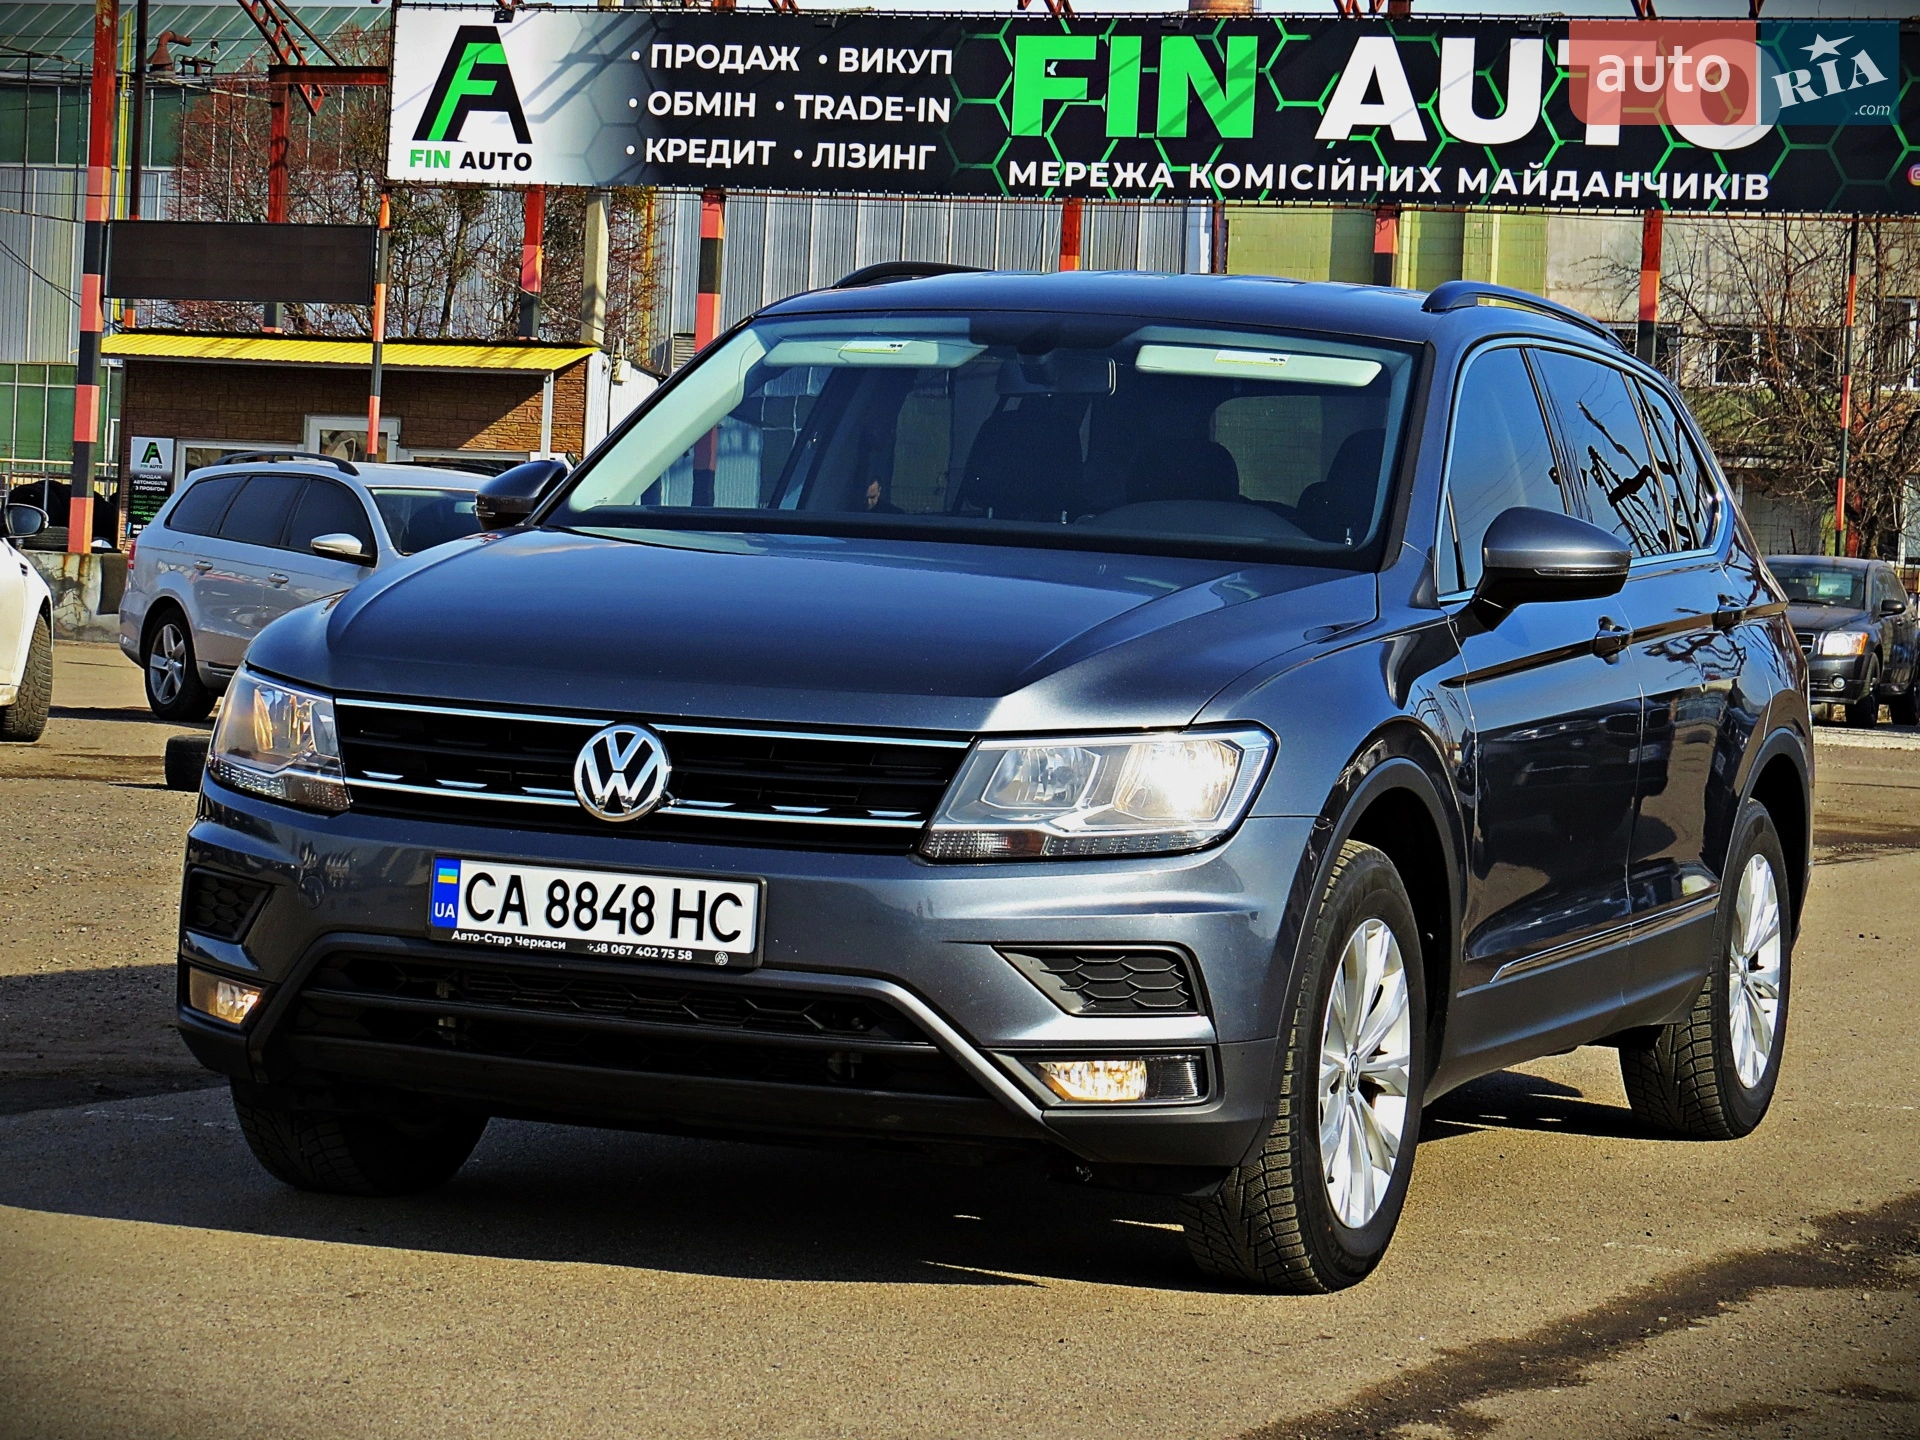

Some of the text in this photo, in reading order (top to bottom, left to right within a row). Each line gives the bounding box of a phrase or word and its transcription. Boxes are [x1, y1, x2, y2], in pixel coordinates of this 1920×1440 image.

[650, 43, 953, 75] ПРОДАЖ ВИКУП
[646, 90, 951, 123] ОБМІН TRADE-IN
[1010, 34, 1781, 150] FIN AUTO
[409, 149, 533, 171] FIN AUTO
[645, 138, 937, 171] КРЕДИТ ЛІЗИНГ
[1008, 157, 1770, 202] МЕРЕЖА КОМІСІЙНИХ МАЙДАНЧИКІВ
[434, 902, 456, 919] UA
[545, 879, 656, 936] 8848
[451, 930, 567, 950] Авто-Стар Черкаси
[610, 944, 633, 956] 067
[635, 946, 659, 958] 402
[660, 948, 675, 960] 75
[677, 950, 693, 961] 58
